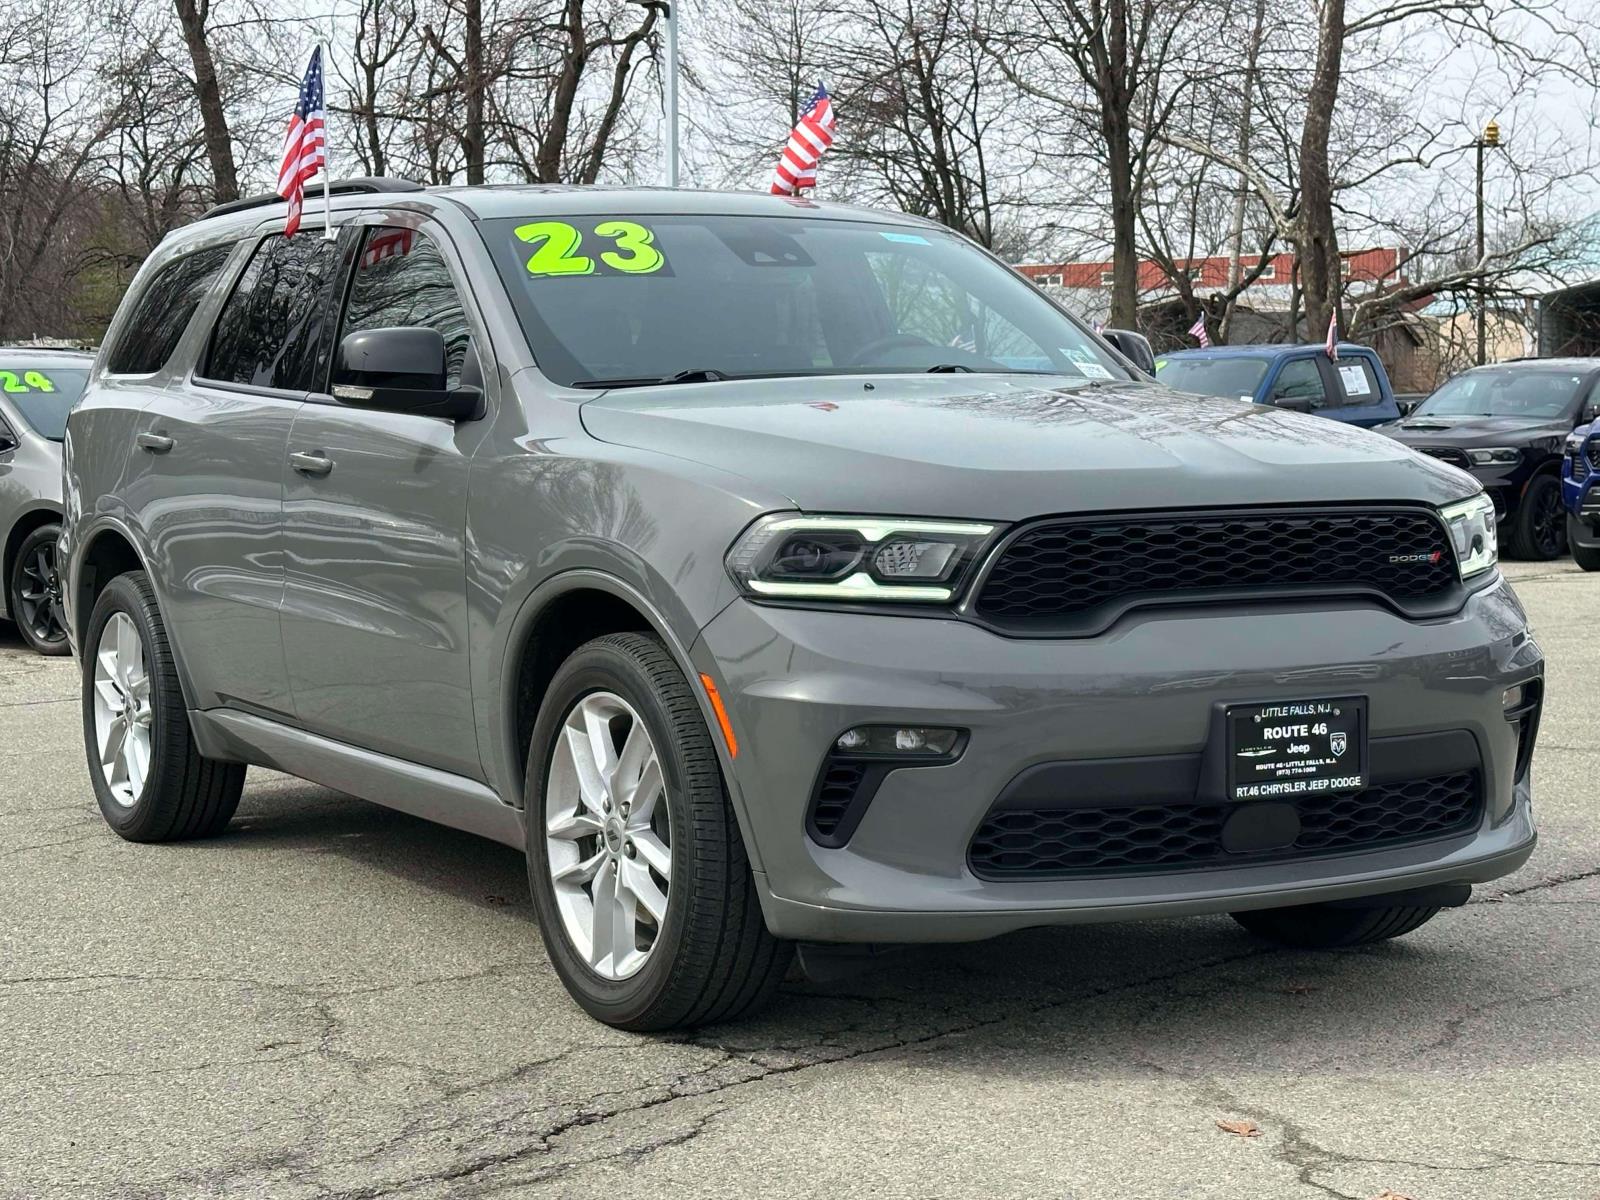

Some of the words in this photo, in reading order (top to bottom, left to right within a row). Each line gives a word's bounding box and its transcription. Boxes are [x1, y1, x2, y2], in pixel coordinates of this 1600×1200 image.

[513, 220, 665, 276] 23
[0, 371, 55, 393] 24
[1261, 706, 1289, 718] LITTLE
[1289, 704, 1316, 716] FALLS,
[1263, 724, 1309, 740] ROUTE
[1311, 722, 1328, 736] 46
[1286, 742, 1310, 755] Jeep
[1260, 781, 1307, 795] CHRYSLER
[1307, 779, 1330, 791] JEEP
[1330, 776, 1361, 788] DODGE
